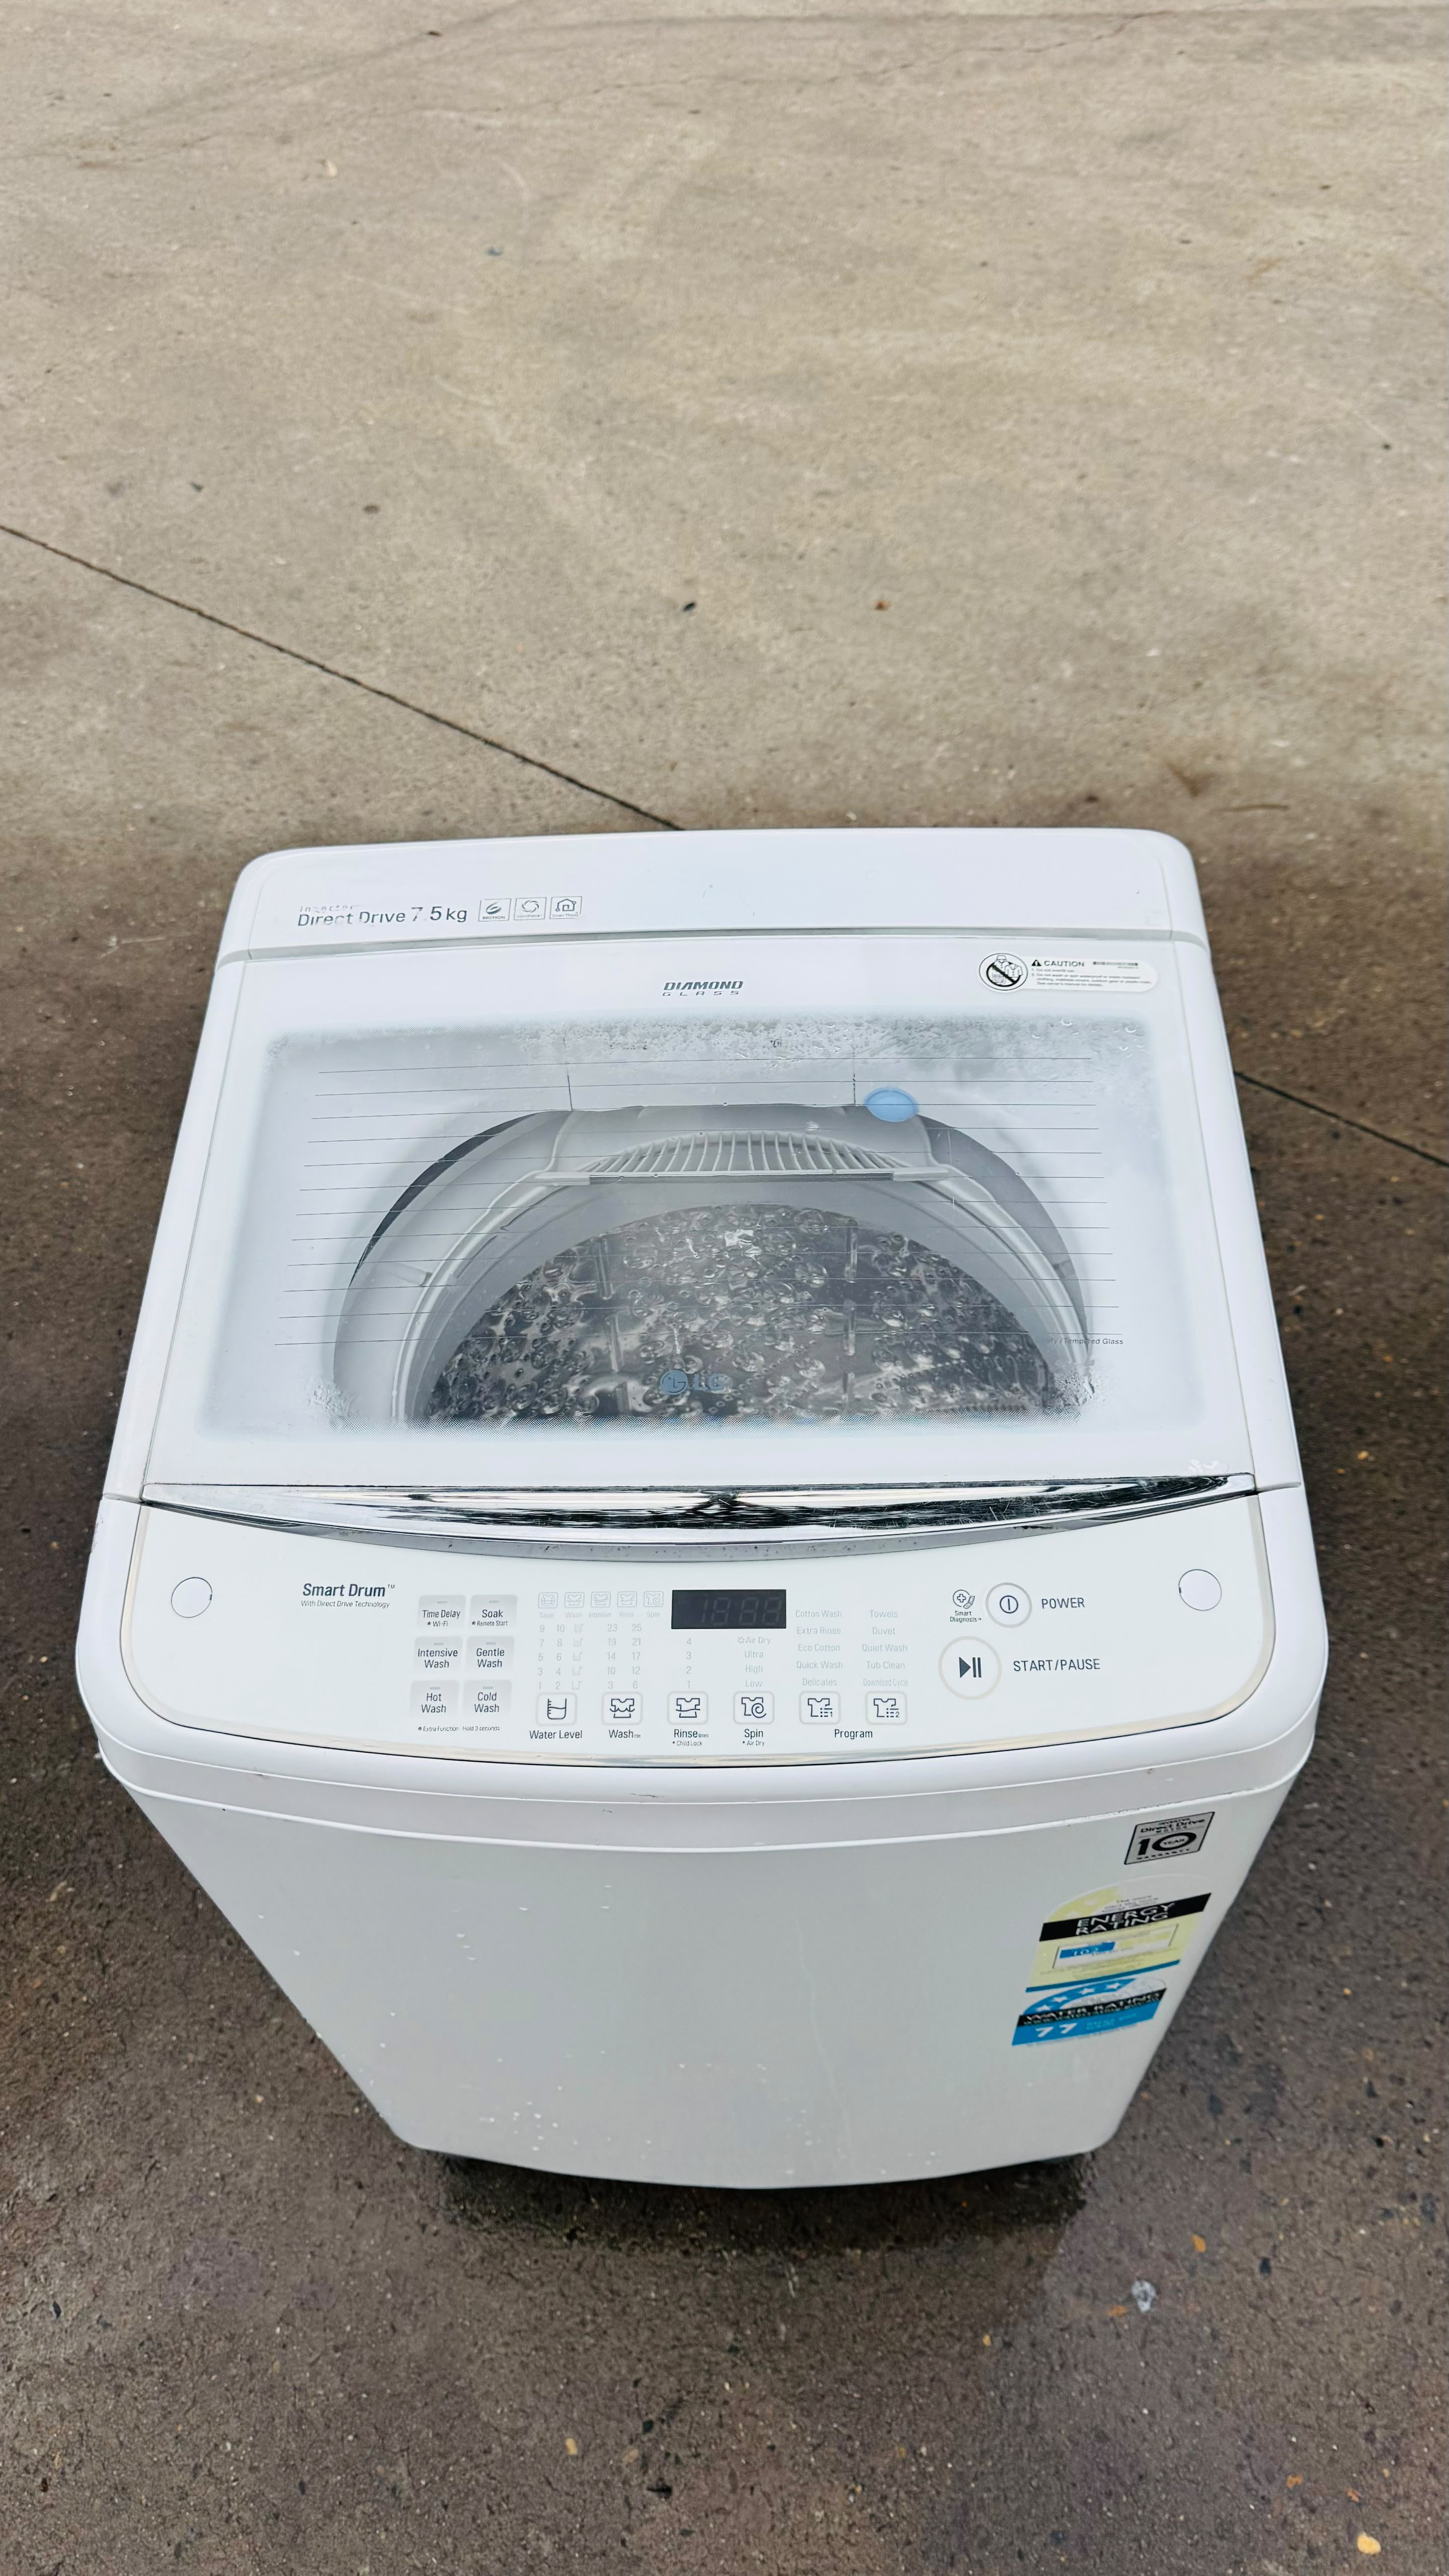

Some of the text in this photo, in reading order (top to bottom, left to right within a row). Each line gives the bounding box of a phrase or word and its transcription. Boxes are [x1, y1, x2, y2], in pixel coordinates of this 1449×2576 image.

[298, 913, 353, 926] Direct
[359, 911, 406, 924] Drive
[663, 981, 744, 991] DIAMOND
[303, 1583, 345, 1596] Smart
[349, 1583, 386, 1597] Drum
[355, 1600, 390, 1609] Technology
[1041, 1597, 1085, 1609] POWER
[422, 1609, 461, 1619] Time Delay
[481, 1609, 504, 1618] Soak
[795, 1609, 842, 1618] Cotton Wash
[869, 1609, 899, 1618] Towels
[539, 1624, 565, 1633] 9 10
[607, 1623, 642, 1632] 23 25
[796, 1626, 842, 1635] Extra Rinse
[872, 1627, 896, 1635] Duvet
[539, 1638, 562, 1647] 7 8
[608, 1638, 641, 1646] 19 21
[686, 1637, 692, 1646] 4
[758, 1637, 771, 1645] Dry
[797, 1643, 841, 1652] Eco Cotton
[861, 1644, 908, 1652] Quiet Wash
[418, 1648, 458, 1657] Intensive
[476, 1648, 505, 1657] Gentle
[538, 1653, 562, 1661] 5 6
[607, 1652, 641, 1660] 14 17
[686, 1651, 692, 1660] 3
[744, 1650, 764, 1658] Ultra
[424, 1659, 450, 1668] Wash
[477, 1659, 503, 1668] Wash
[796, 1660, 843, 1669] Quick Wash
[865, 1661, 906, 1669] Tub Clean
[1013, 1658, 1101, 1672] START/PAUSE
[537, 1667, 561, 1676] 3 4
[607, 1666, 640, 1675] 10 12
[686, 1665, 692, 1674] 2
[745, 1664, 763, 1674] High
[555, 1681, 561, 1690] 2
[608, 1680, 638, 1689] 3 6
[745, 1679, 763, 1687] Low
[802, 1678, 838, 1686] Delicates
[426, 1693, 442, 1702] Hot
[477, 1692, 498, 1701] Cold
[421, 1704, 447, 1713] Wash
[474, 1704, 500, 1713] Wash
[529, 1730, 583, 1739] Water Level
[608, 1729, 634, 1738] Wash
[674, 1729, 698, 1738] Rinse
[744, 1728, 764, 1739] Spin
[834, 1729, 873, 1740] Program
[1078, 1902, 1176, 1927] ENERGY
[1076, 1912, 1169, 1936] RATING
